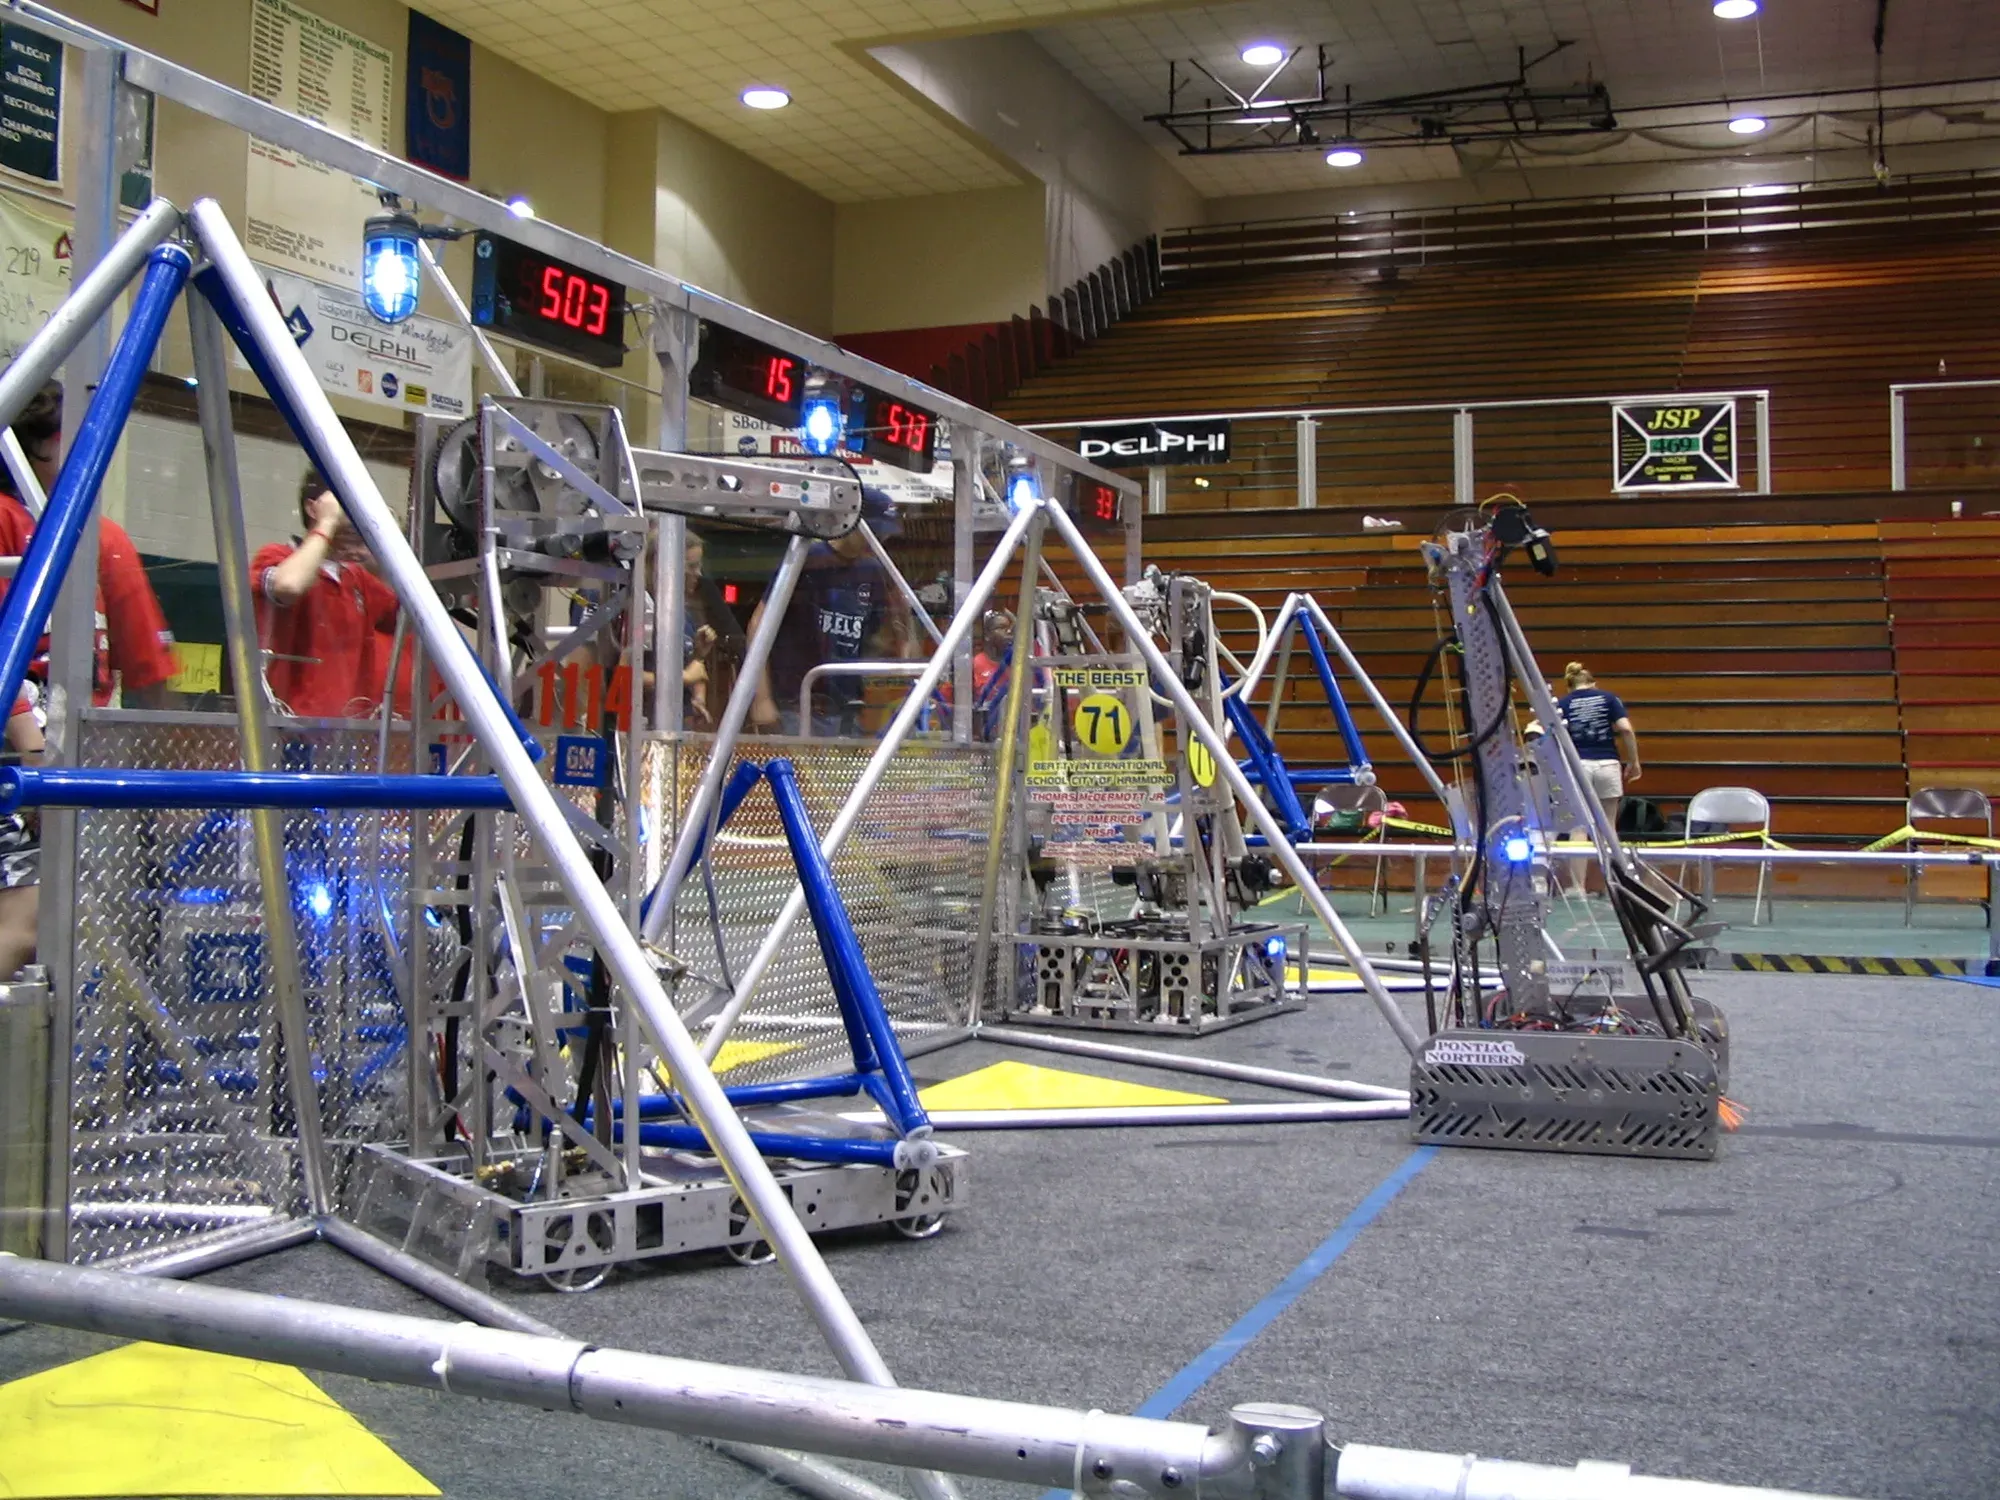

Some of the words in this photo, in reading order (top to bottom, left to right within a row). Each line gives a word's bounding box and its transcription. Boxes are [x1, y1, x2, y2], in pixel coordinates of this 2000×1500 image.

[6, 247, 41, 276] 219
[540, 265, 610, 336] 503
[331, 325, 417, 361] DELPHI
[767, 357, 793, 402] 15
[887, 404, 928, 452] 573
[1647, 408, 1701, 430] JSP
[1080, 432, 1226, 458] DELPHI
[1652, 437, 1692, 453] 469
[1055, 672, 1087, 685] THE
[1091, 672, 1145, 685] BEAST
[537, 660, 634, 732] 1114
[1082, 705, 1122, 745] 71
[566, 745, 596, 770] GM
[1033, 761, 1076, 770] BEATTY
[1078, 761, 1165, 770] INTERNATIONAL
[1026, 776, 1067, 785] SCHOOL
[1072, 776, 1095, 785] CITY
[1099, 776, 1113, 785] OF
[1118, 775, 1174, 785] HAMMOND
[1032, 792, 1076, 802] THOMAS
[1087, 814, 1143, 824] AMERICAS
[1084, 828, 1113, 837] NASA
[1427, 1051, 1523, 1065] NORTHERN
[1438, 1041, 1514, 1054] PONTIAC
